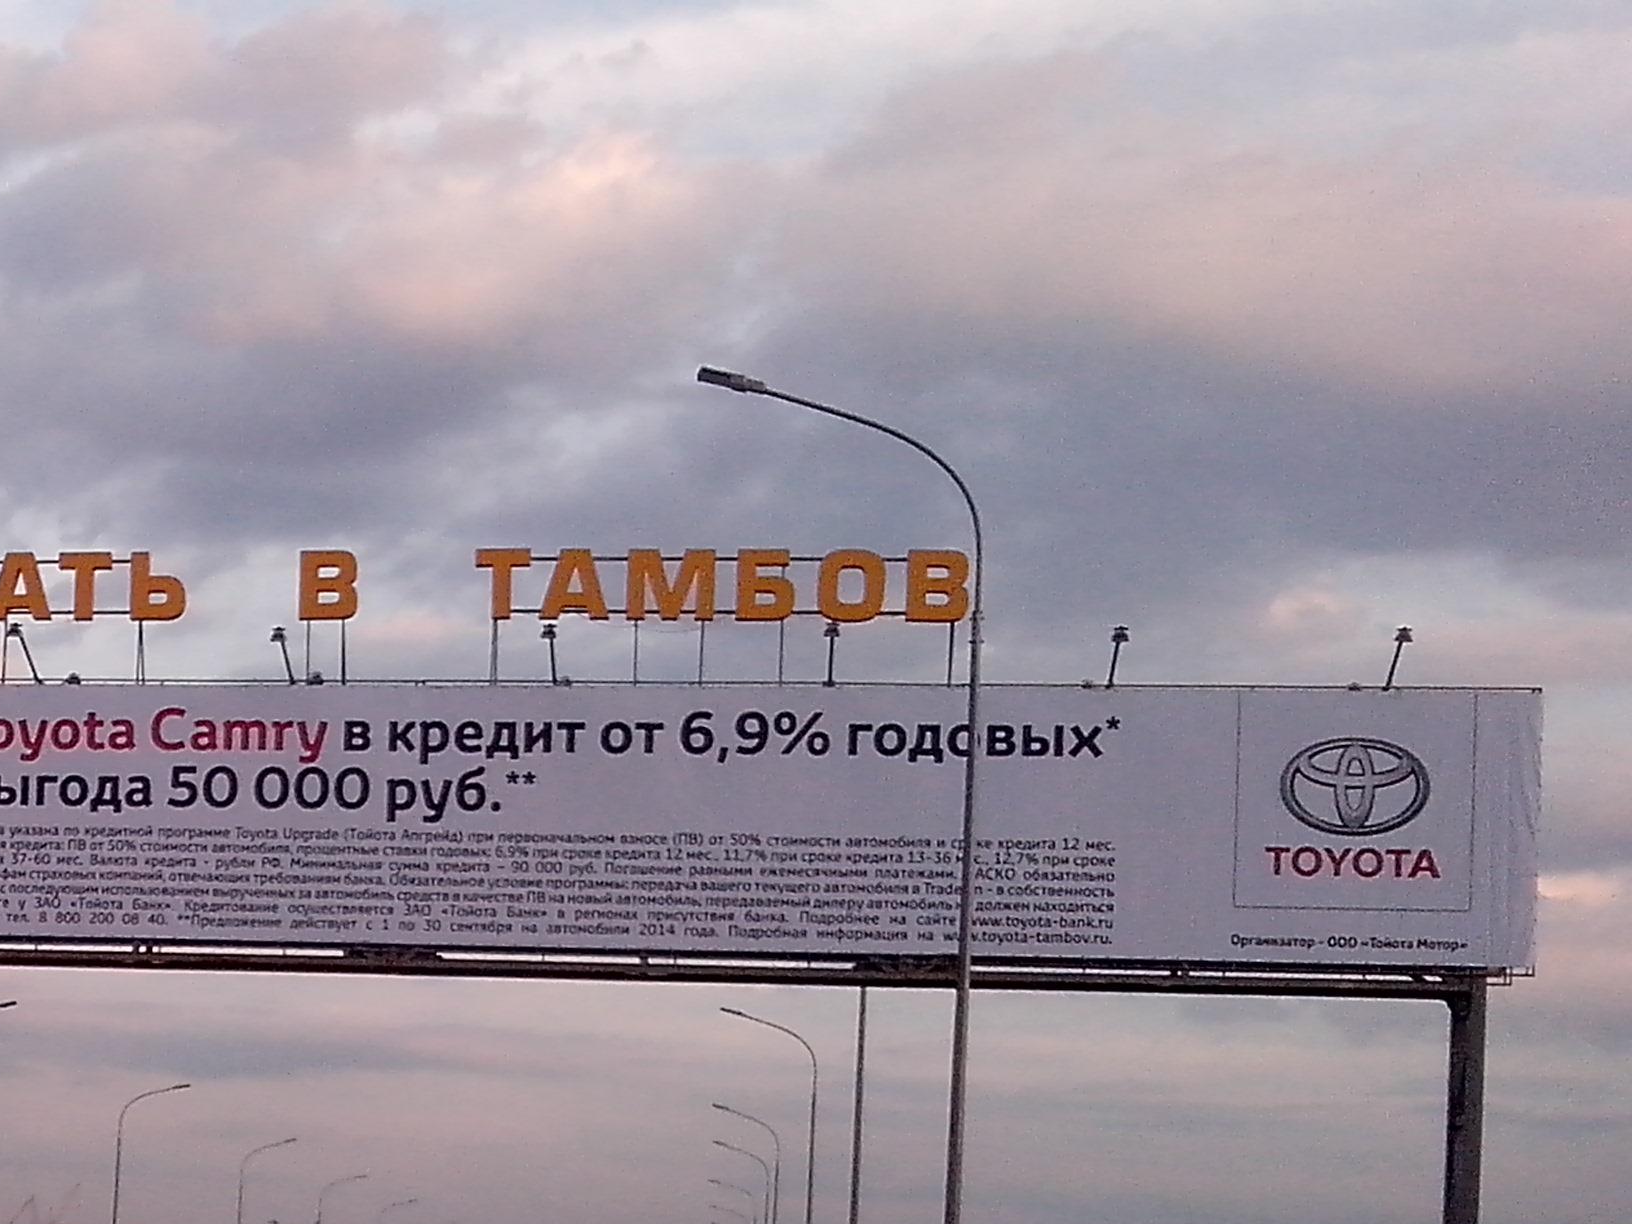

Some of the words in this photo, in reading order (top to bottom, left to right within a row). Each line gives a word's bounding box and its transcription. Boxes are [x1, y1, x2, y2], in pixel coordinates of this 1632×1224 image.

[298, 550, 358, 622] В
[475, 548, 969, 623] ТАМБОВ
[150, 707, 328, 764] Camry
[342, 720, 371, 753] в
[388, 719, 585, 765] кредит
[600, 720, 665, 755] от
[679, 711, 831, 764] 6,9%
[168, 766, 238, 811] 50
[254, 766, 370, 811] 000
[63, 828, 79, 837] по
[84, 825, 153, 840] кредитной
[158, 829, 230, 841] программе
[235, 827, 278, 842] Toyota
[283, 828, 339, 843] Upgrade
[344, 828, 396, 844] (Тойота
[467, 833, 494, 845] при
[498, 833, 615, 846] первоначальном
[620, 835, 667, 844] взносе
[672, 833, 703, 848] (ПВ)
[708, 836, 723, 845] от
[730, 833, 761, 846] 50%
[766, 837, 841, 847] стоимости
[845, 835, 931, 848] автомобиля
[998, 840, 1056, 853] кредита
[1062, 838, 1079, 850] 12
[1085, 841, 1116, 850] мес.
[68, 838, 86, 850] ПВ
[89, 841, 105, 850] от
[107, 839, 136, 851] 50%
[140, 842, 207, 852] стоимости
[382, 846, 428, 855] ставки
[532, 848, 558, 860] при
[562, 848, 601, 861] сроке
[604, 849, 661, 862] кредита
[666, 847, 683, 859] 12
[770, 851, 798, 864] при
[801, 852, 842, 865] сроке
[845, 853, 903, 865] кредита
[908, 851, 951, 863] 13-36
[1042, 856, 1069, 868] при
[1073, 856, 1116, 869] сроке
[11, 852, 50, 864] 37-60
[56, 856, 84, 865] мес.
[89, 854, 138, 866] Валюта
[144, 857, 196, 870] кредита
[215, 856, 255, 871] рубли
[388, 861, 429, 873] сумма
[436, 862, 490, 874] кредита
[510, 860, 529, 872] 90
[534, 860, 562, 873] 000
[569, 861, 597, 876] руб.
[604, 862, 682, 874] Погашение
[689, 866, 752, 878] равными
[759, 867, 868, 877] ежемесячными
[1022, 868, 1115, 881] обязательно
[1265, 846, 1441, 879] TOYOTA
[29, 870, 96, 883] страховых
[253, 871, 341, 887] требованиям
[631, 880, 697, 893] передача
[700, 881, 751, 891] вашего
[754, 882, 818, 895] текущего
[822, 880, 909, 893] автомобиля
[1007, 883, 1114, 896] собственность
[8, 884, 99, 897] последующим
[397, 891, 449, 903] средств
[526, 890, 546, 902] ПВ
[548, 893, 564, 902] на
[567, 890, 612, 903] новый
[813, 897, 864, 910] дилеру
[974, 900, 1030, 911] должен
[1032, 901, 1114, 913] находиться
[34, 897, 61, 909] ЗАО
[184, 900, 279, 915] Кредитование
[404, 903, 431, 916] ЗАО
[574, 909, 638, 922] регионах
[647, 911, 734, 924] присутствия
[799, 911, 880, 926] Подробнее
[889, 915, 906, 924] на
[916, 912, 956, 925] сайте
[6, 913, 30, 922] тел.
[55, 911, 81, 923] 800
[88, 912, 114, 924] 200
[122, 913, 139, 924] 08
[289, 916, 357, 931] действует
[398, 921, 415, 930] по
[423, 918, 442, 930] 30
[450, 919, 512, 934] сентября
[521, 923, 538, 932] на
[638, 922, 675, 935] 2014
[728, 924, 807, 940] Подробная
[816, 926, 908, 942] информация
[918, 930, 934, 940] на
[1231, 933, 1315, 949] Организатор
[1327, 935, 1358, 948] ООО
